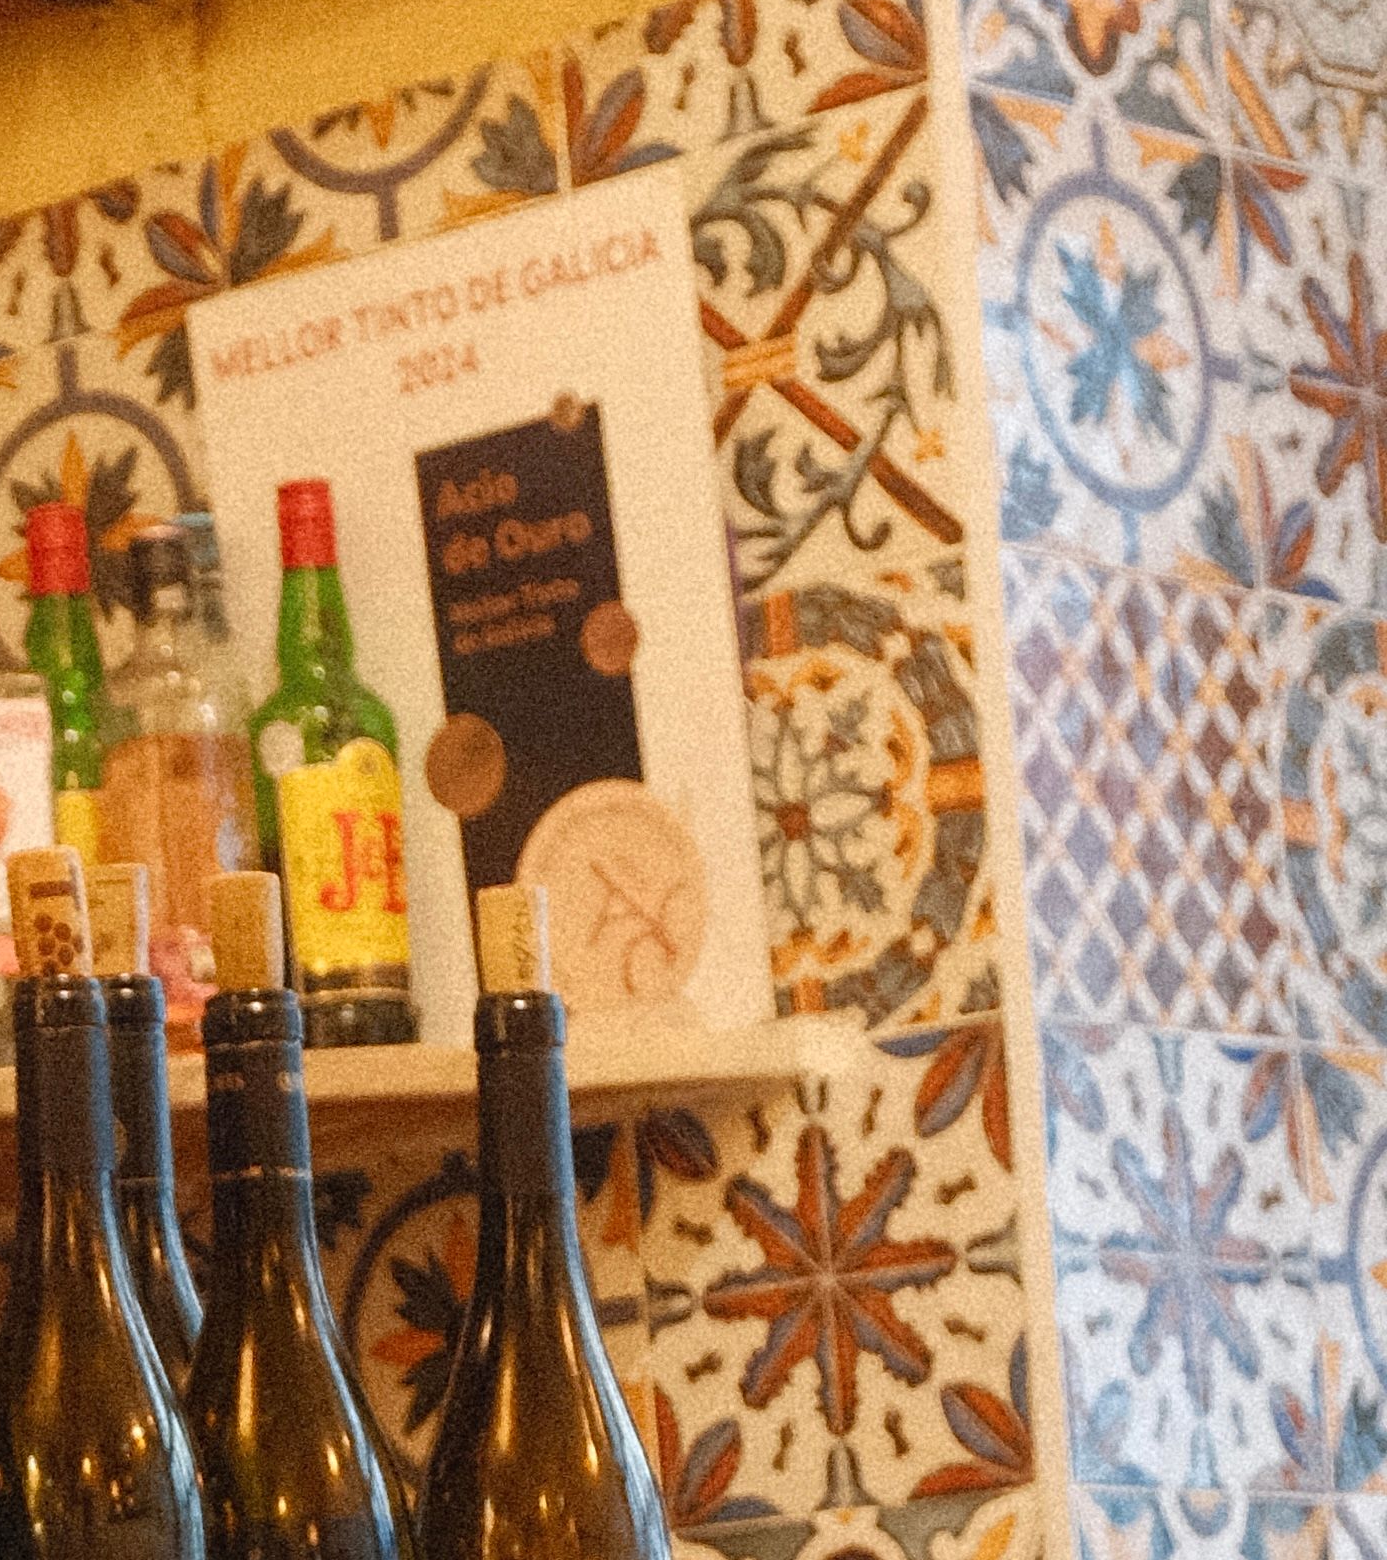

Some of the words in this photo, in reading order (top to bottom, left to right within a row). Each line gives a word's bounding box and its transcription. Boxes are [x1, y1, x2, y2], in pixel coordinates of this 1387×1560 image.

[353, 283, 460, 337] TINTO
[468, 269, 512, 313] DE
[519, 227, 663, 297] GALICIA
